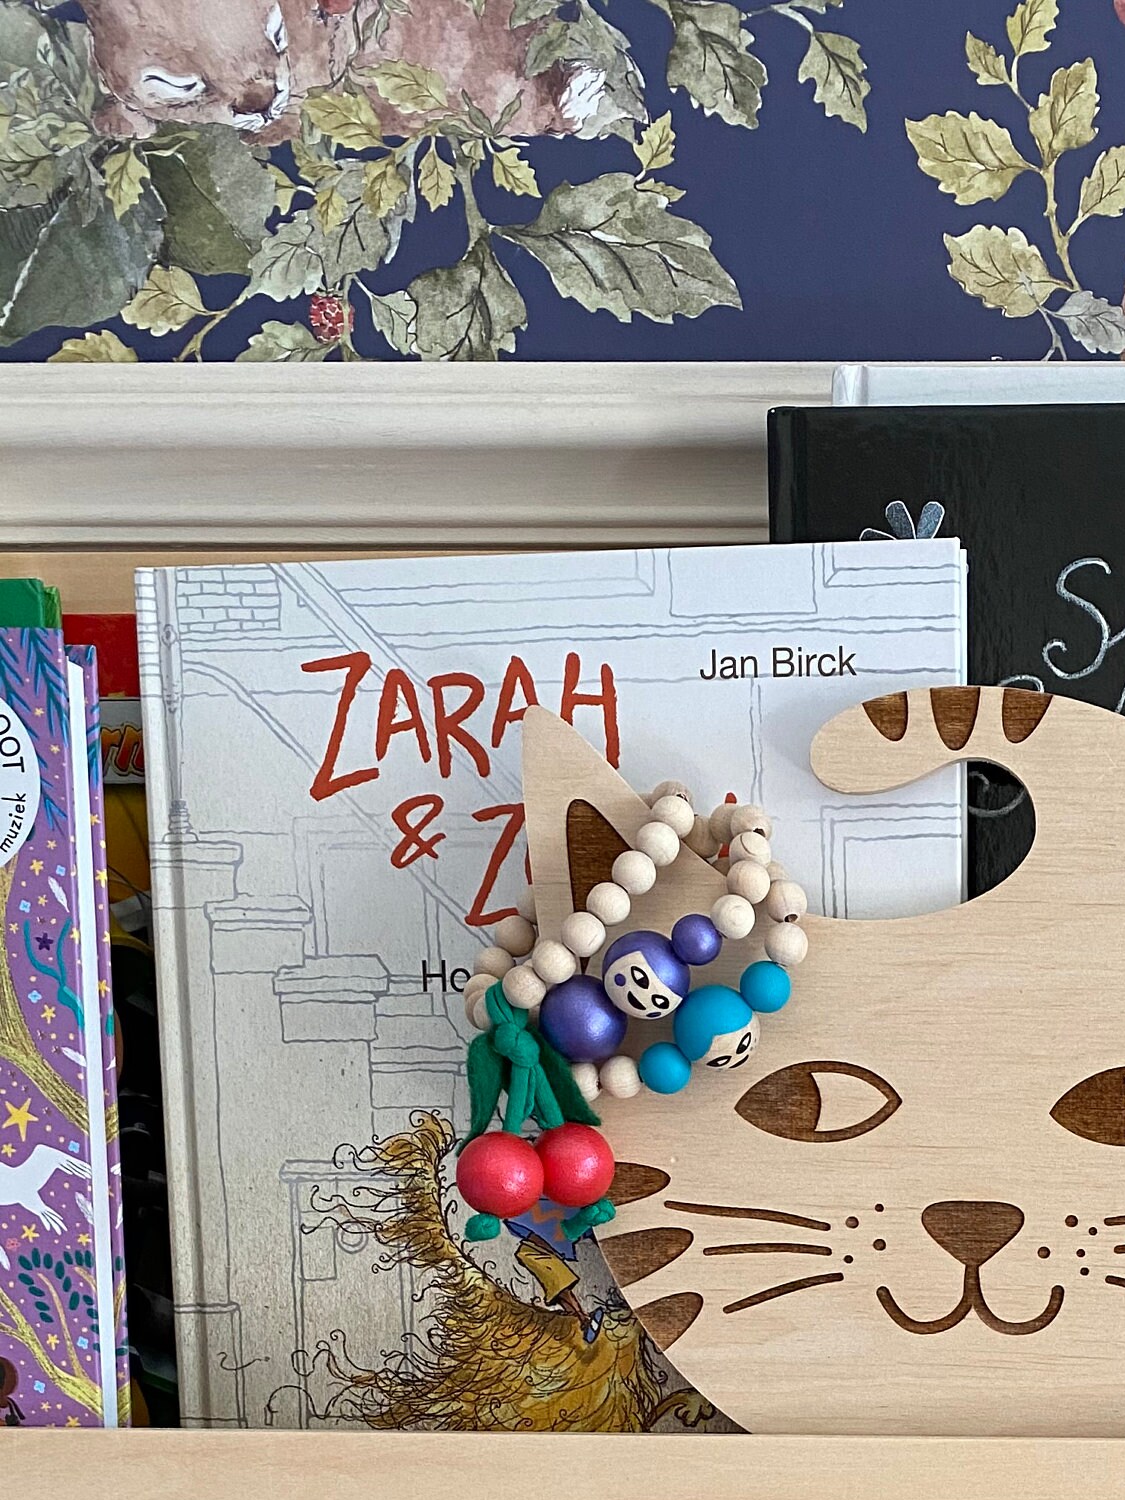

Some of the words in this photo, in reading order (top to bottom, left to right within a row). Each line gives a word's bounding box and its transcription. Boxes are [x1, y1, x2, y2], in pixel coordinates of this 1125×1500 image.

[700, 648, 759, 681] Jan
[772, 645, 857, 679] Birck
[301, 651, 621, 801] ZARAH
[0, 793, 26, 853] muziek
[390, 793, 446, 869] &
